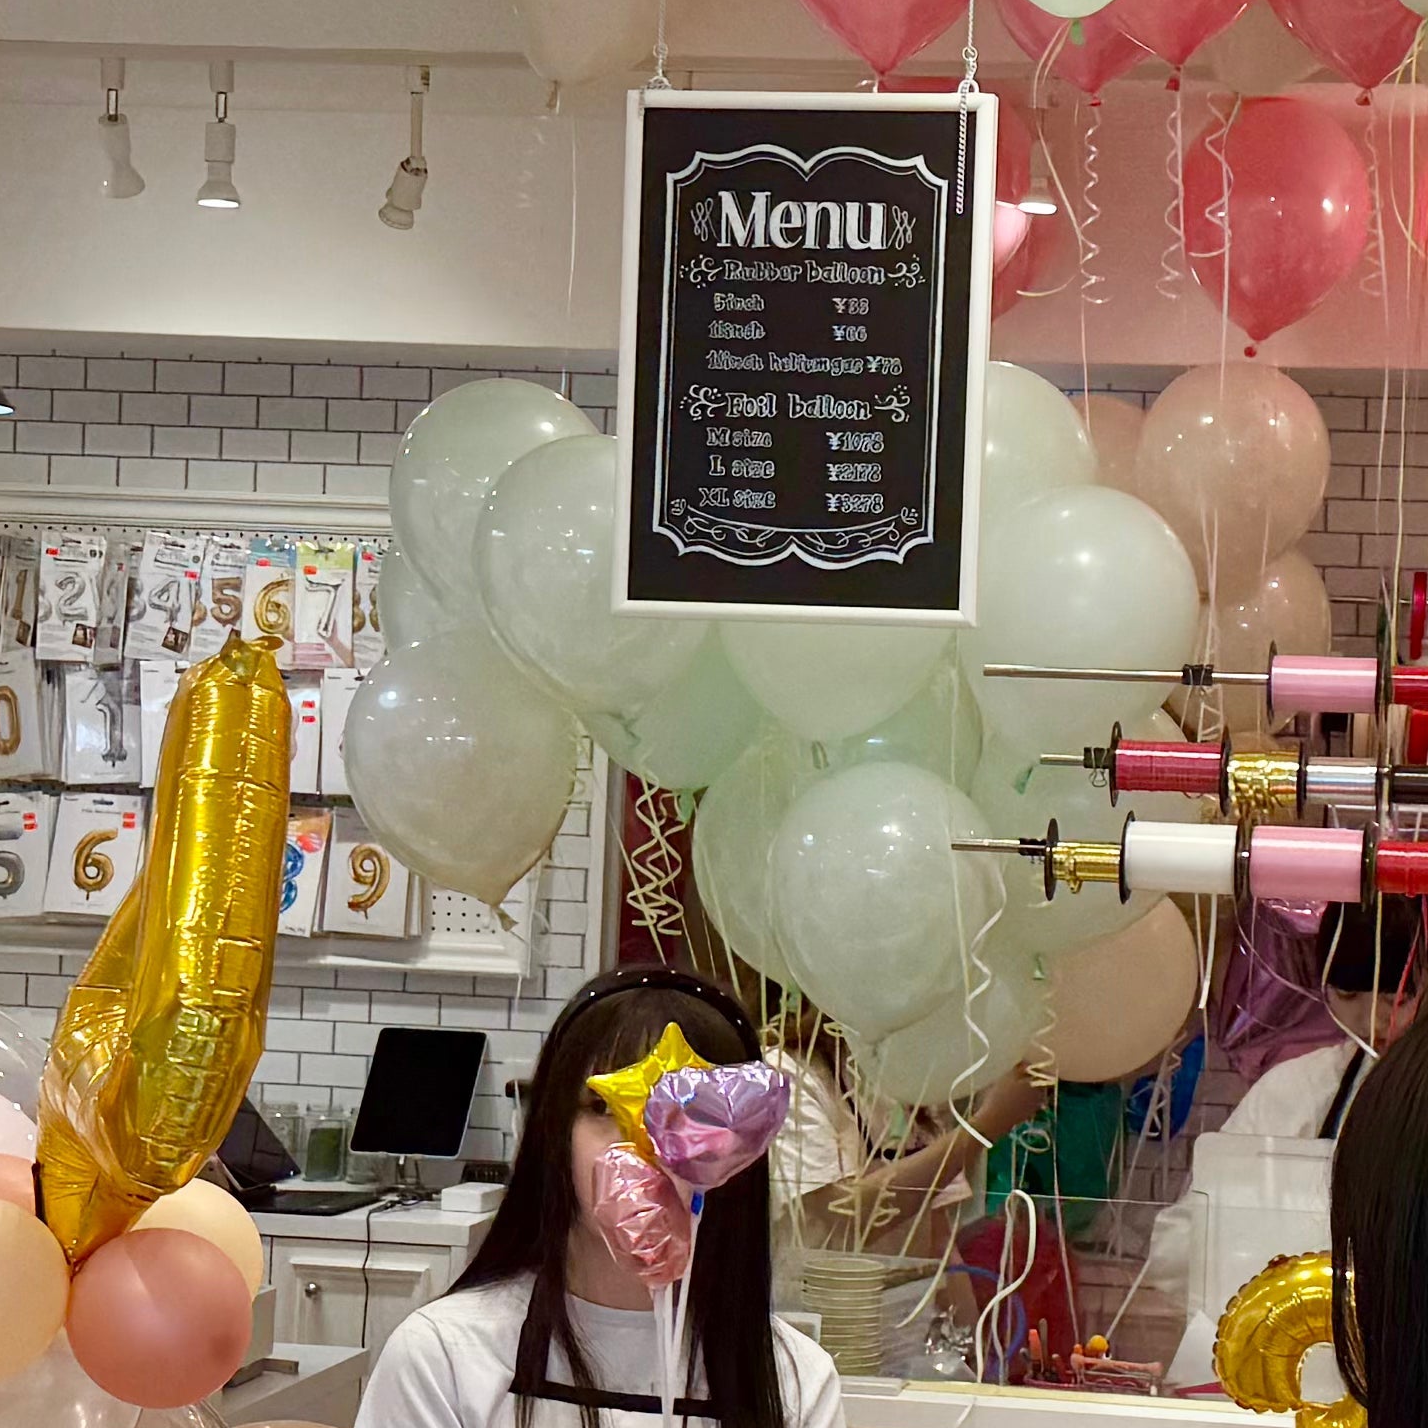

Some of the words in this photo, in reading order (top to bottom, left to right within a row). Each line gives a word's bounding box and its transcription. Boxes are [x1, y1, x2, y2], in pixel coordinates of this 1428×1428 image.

[716, 190, 887, 250] Menu
[723, 258, 803, 282] Rubber
[804, 259, 886, 285] balloon
[725, 392, 778, 418] Foil
[788, 392, 872, 420] balloon
[706, 427, 730, 447] M
[709, 454, 726, 476] L
[731, 458, 775, 479] size
[699, 487, 730, 507] XL
[732, 489, 776, 509] size
[55, 571, 89, 625] 2
[147, 578, 182, 624] 4
[210, 576, 243, 628] 5
[254, 576, 294, 636] 6
[304, 576, 346, 639] 7
[72, 827, 119, 901] 6
[347, 843, 391, 920] 9
